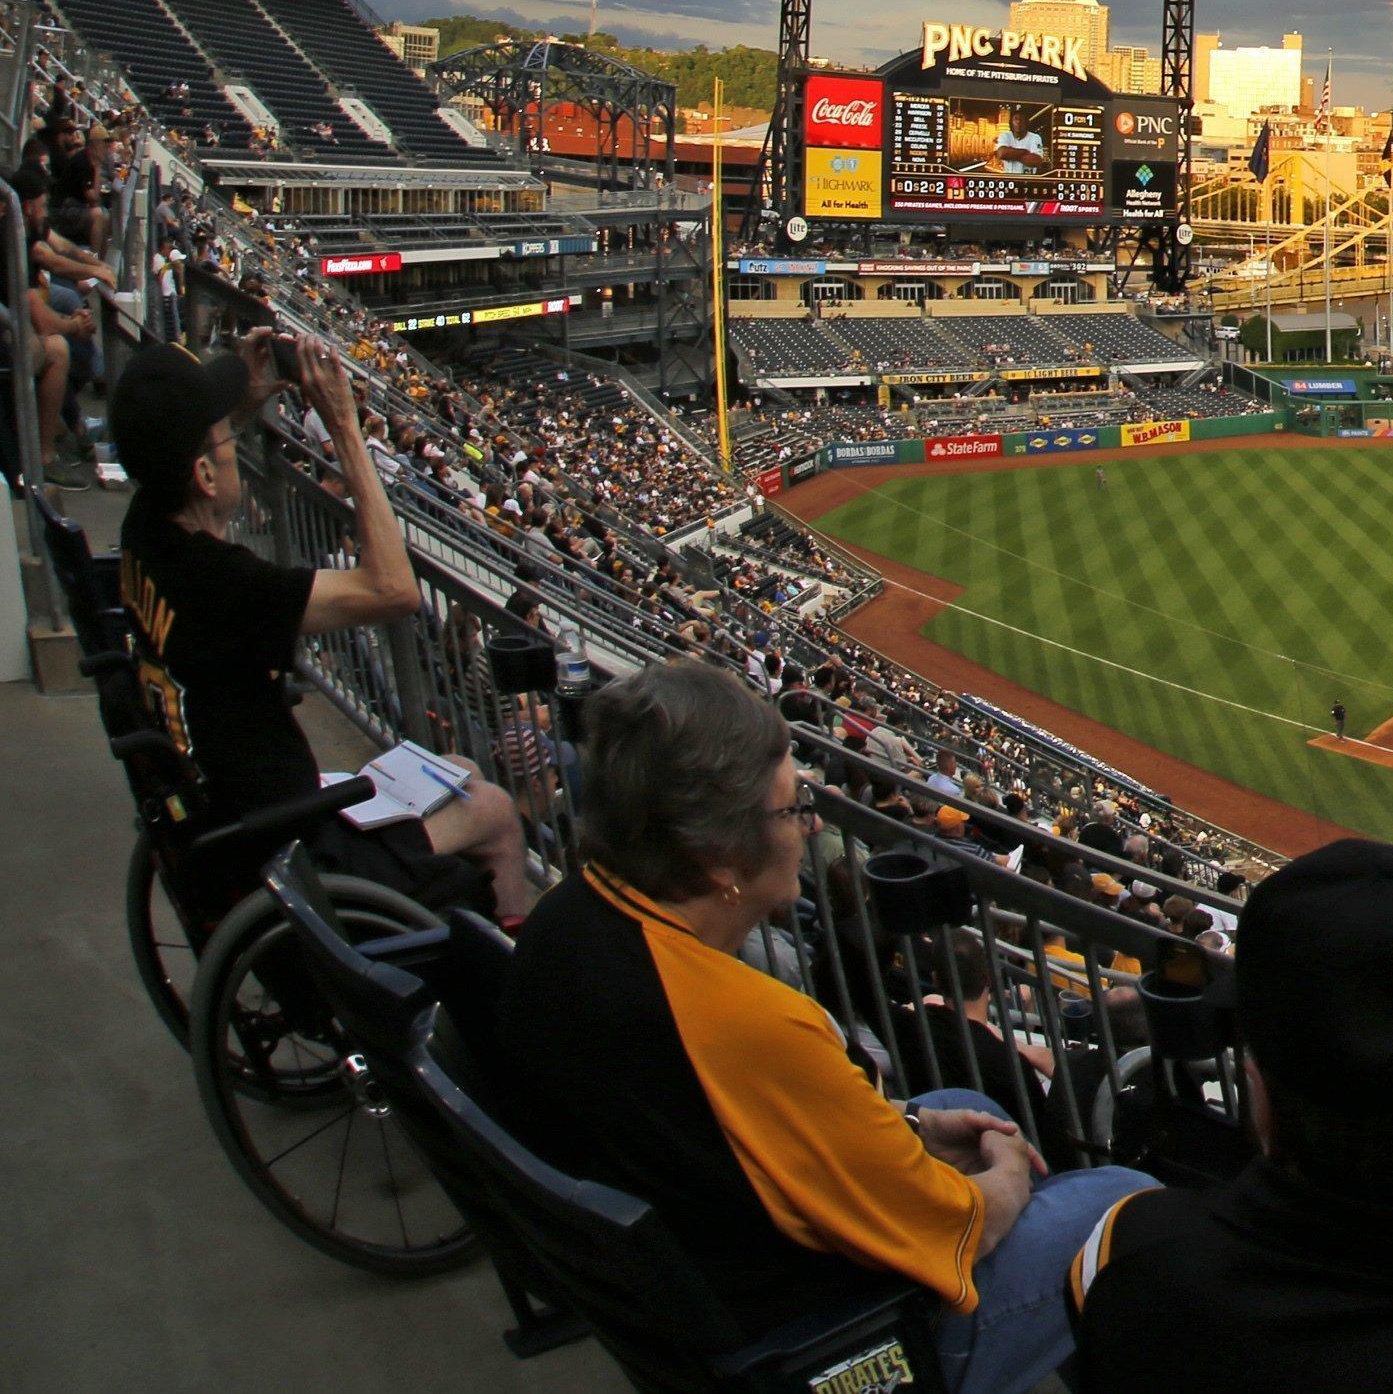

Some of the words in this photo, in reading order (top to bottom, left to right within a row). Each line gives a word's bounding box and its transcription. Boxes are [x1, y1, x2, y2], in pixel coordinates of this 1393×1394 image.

[921, 21, 994, 70] PNC
[1000, 28, 1088, 82] PARK
[946, 67, 966, 77] HOME
[967, 69, 976, 78] OF
[977, 70, 989, 79] THE
[990, 71, 1031, 82] PITTSBURGH
[1032, 74, 1058, 84] PIRATES
[1137, 115, 1172, 134] PNC
[816, 177, 874, 192] HIGHMARK
[920, 181, 928, 193] 2
[936, 182, 944, 193] 2
[1126, 189, 1162, 200] Allegheny
[821, 200, 831, 208] All
[833, 201, 843, 209] for
[845, 201, 868, 209] Health
[1123, 209, 1144, 217] Health
[790, 222, 805, 234] Lite
[1179, 229, 1191, 239] Lite
[547, 299, 564, 312] ROOT
[393, 321, 406, 331] BALL
[408, 318, 417, 330] 22
[899, 375, 923, 383] IRON
[1034, 369, 1059, 378] LIGHT
[1060, 368, 1079, 377] BEER
